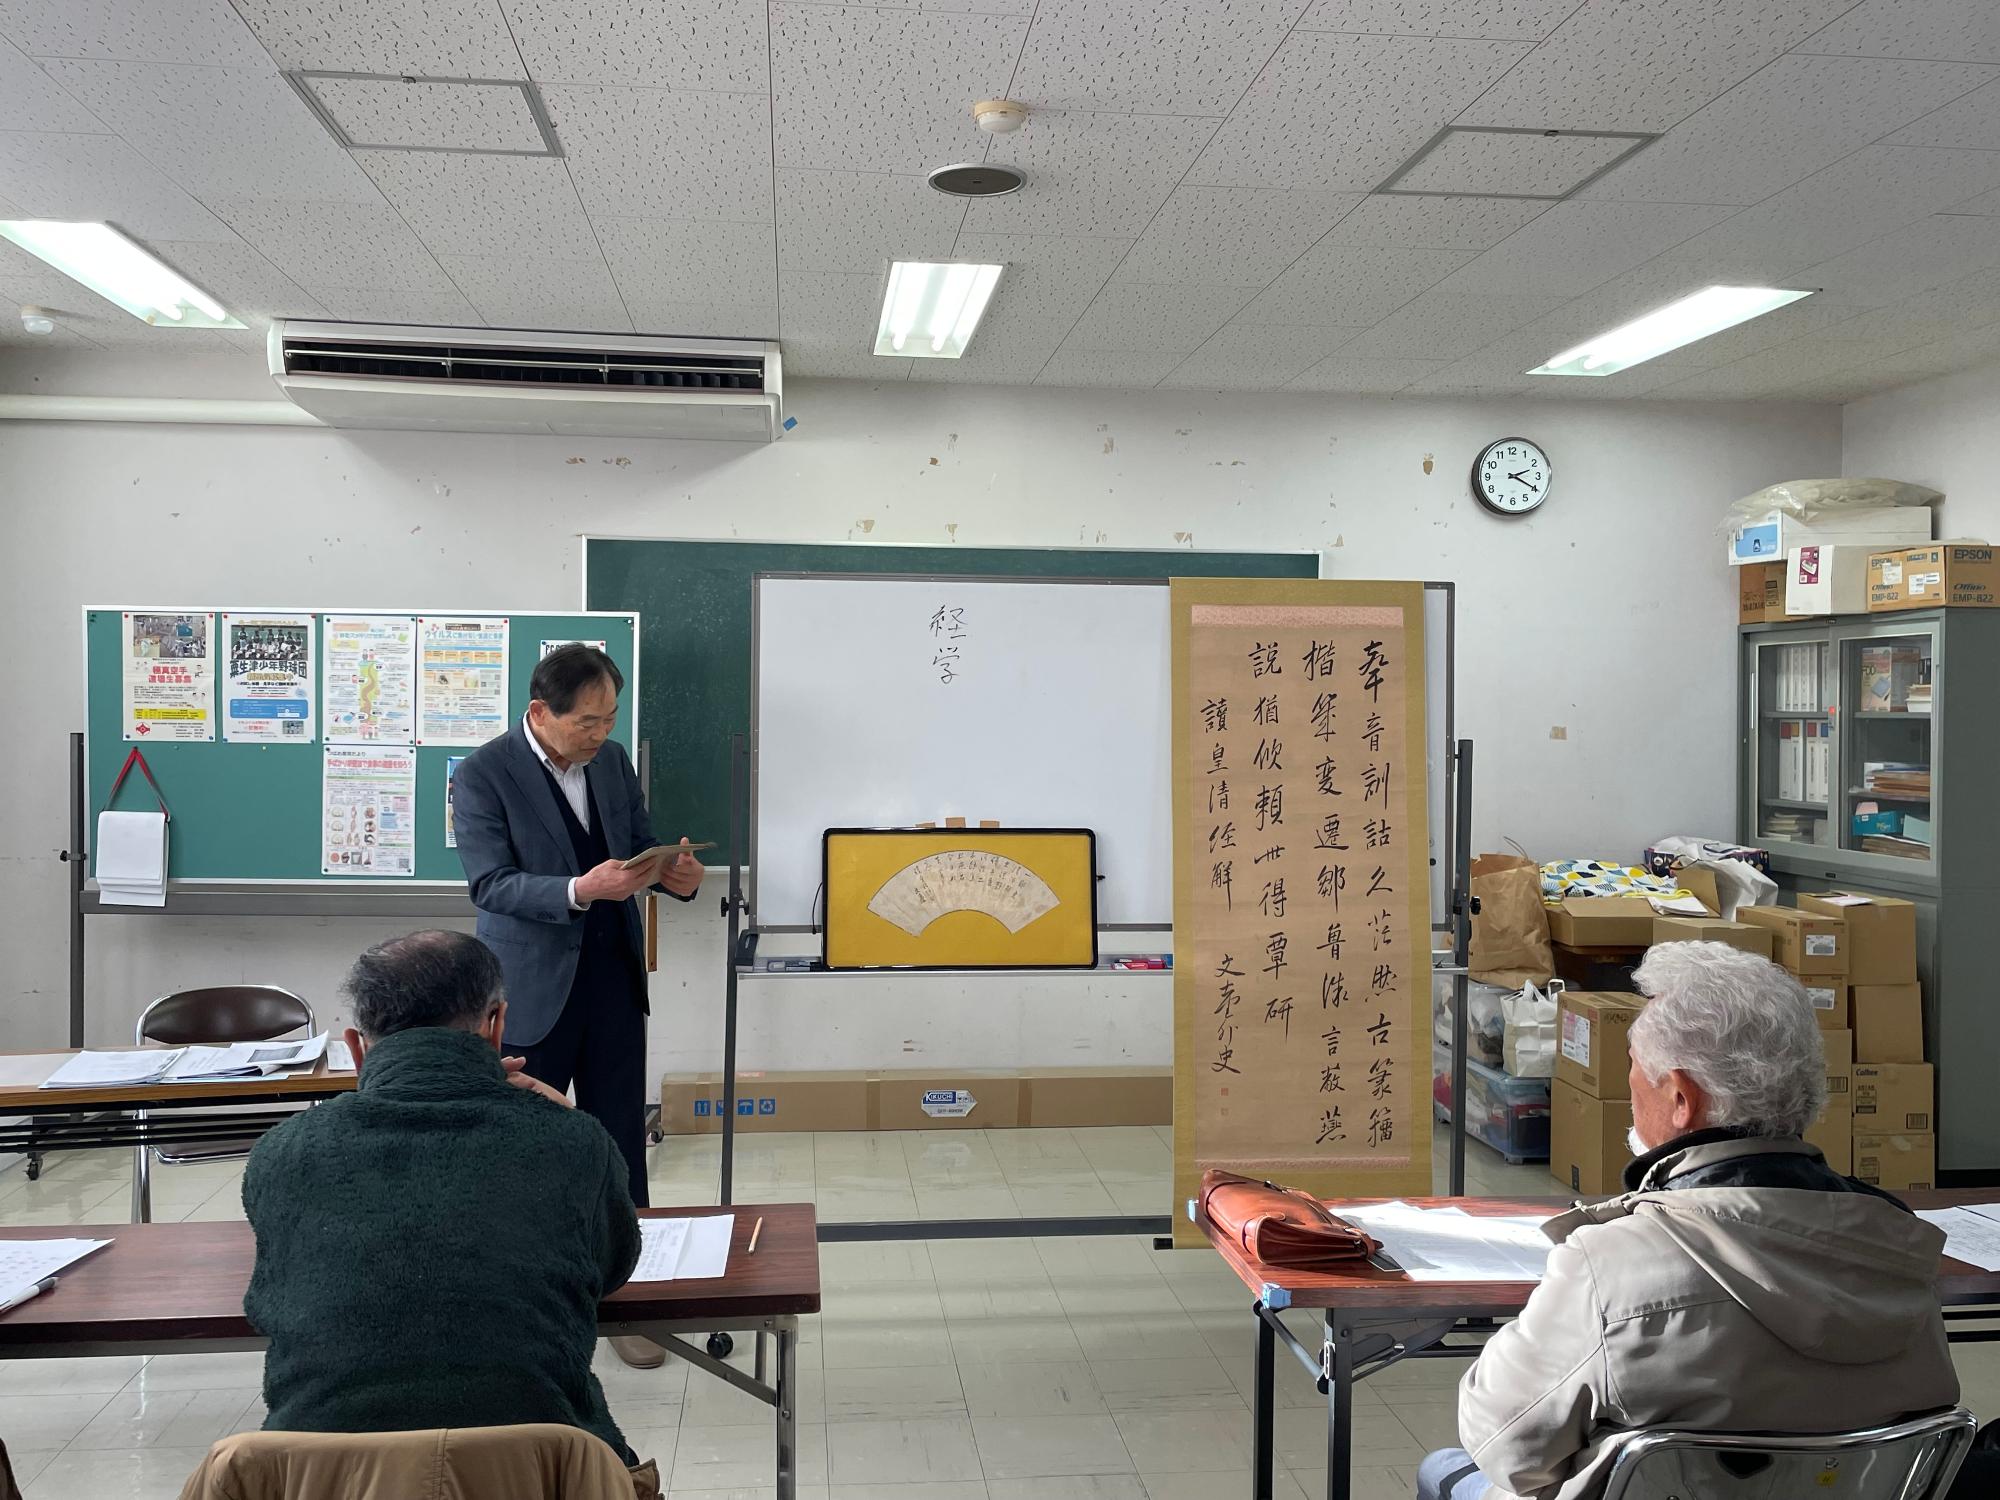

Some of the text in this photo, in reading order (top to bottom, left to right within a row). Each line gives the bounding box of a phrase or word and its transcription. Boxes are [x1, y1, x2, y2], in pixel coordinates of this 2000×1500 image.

[1496, 451, 1504, 459] 11
[1507, 447, 1517, 455] 12
[1523, 450, 1527, 459] 1
[1487, 461, 1497, 469] 10
[1531, 459, 1537, 467] 2
[1485, 472, 1491, 481] 9
[1535, 472, 1541, 480] 3
[1488, 485, 1495, 493] 8
[1531, 485, 1538, 493] 4
[1498, 494, 1504, 502] 7
[1509, 497, 1516, 505] 6
[1522, 494, 1528, 502] 5
[1953, 549, 1992, 560] EPSON
[1871, 592, 1899, 602] EMP-822
[1952, 593, 1994, 603] EMP-822
[929, 605, 968, 684] 経学
[925, 1092, 954, 1102] KIKUCHI
